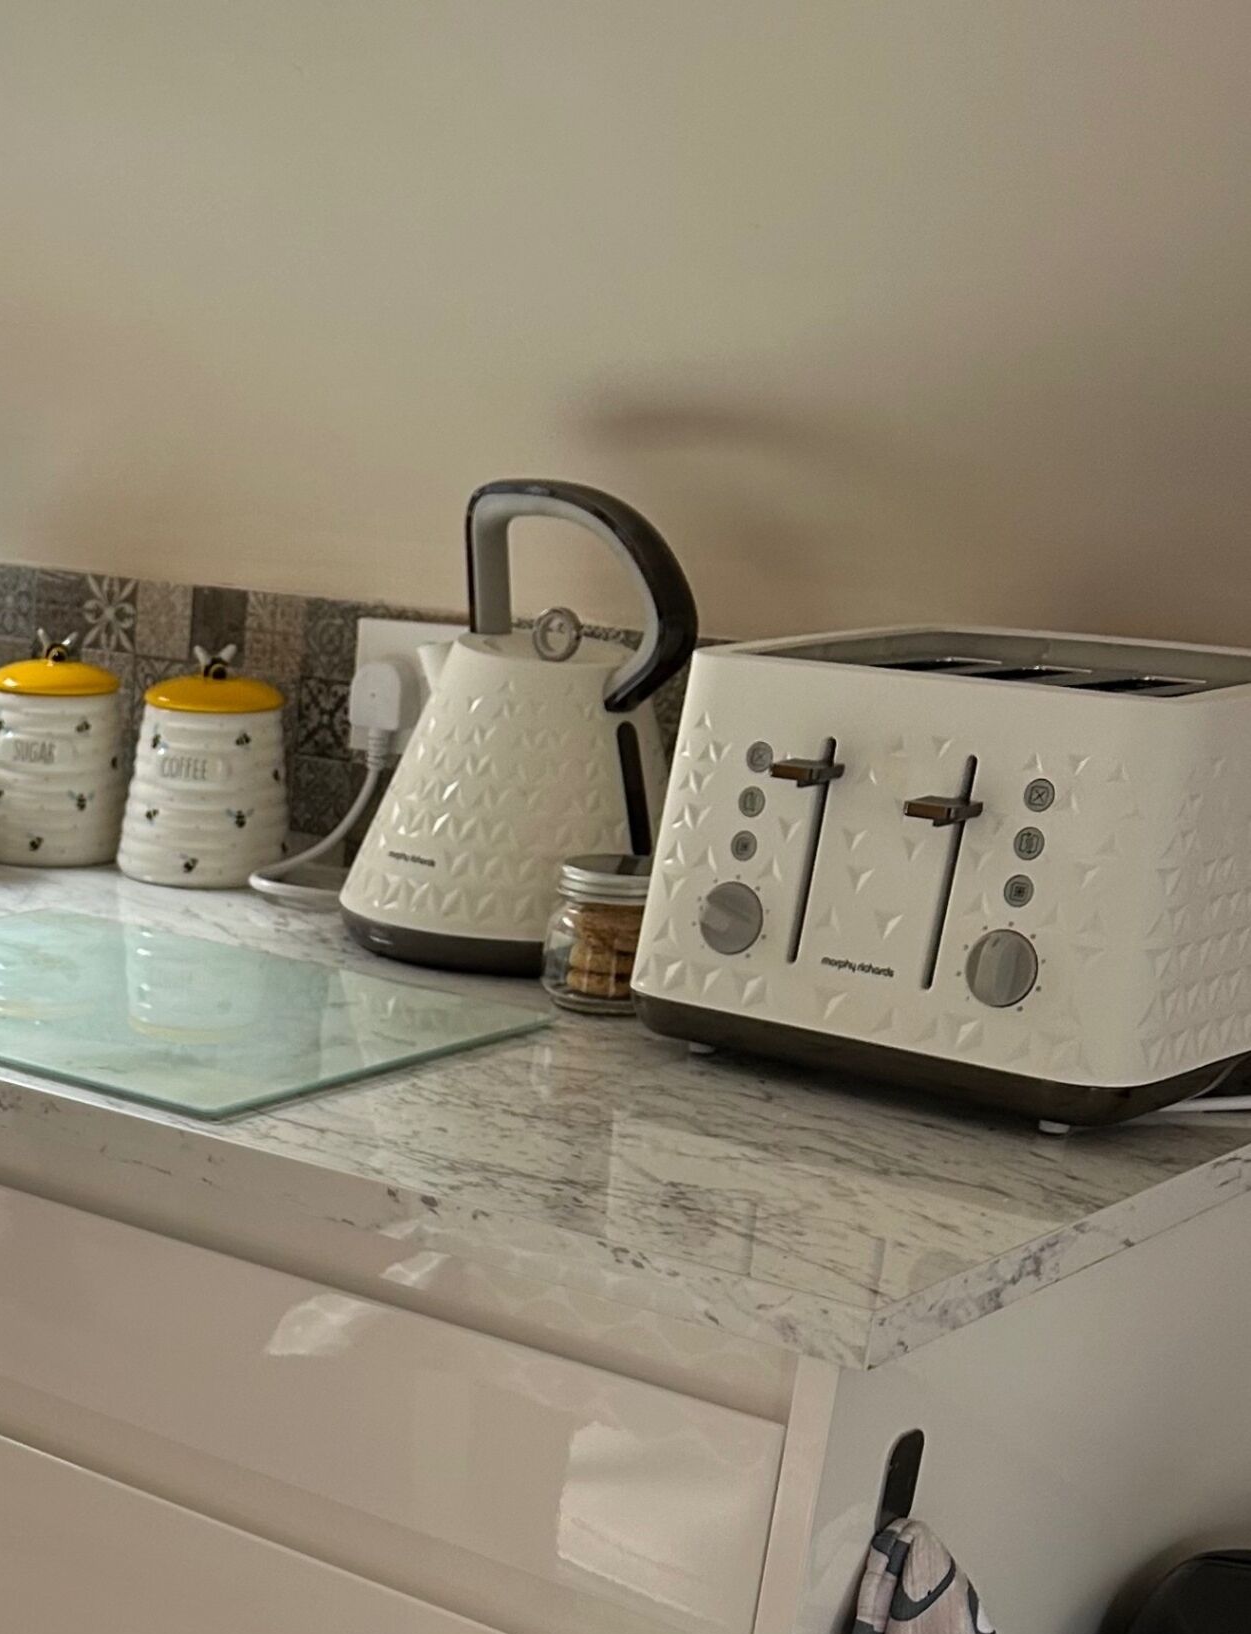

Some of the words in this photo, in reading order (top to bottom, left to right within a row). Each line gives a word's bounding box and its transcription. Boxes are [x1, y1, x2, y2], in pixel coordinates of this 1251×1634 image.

[13, 740, 56, 766] SUGAR
[159, 756, 208, 780] COFFEE
[821, 956, 856, 973] morphy
[856, 962, 894, 978] richards
